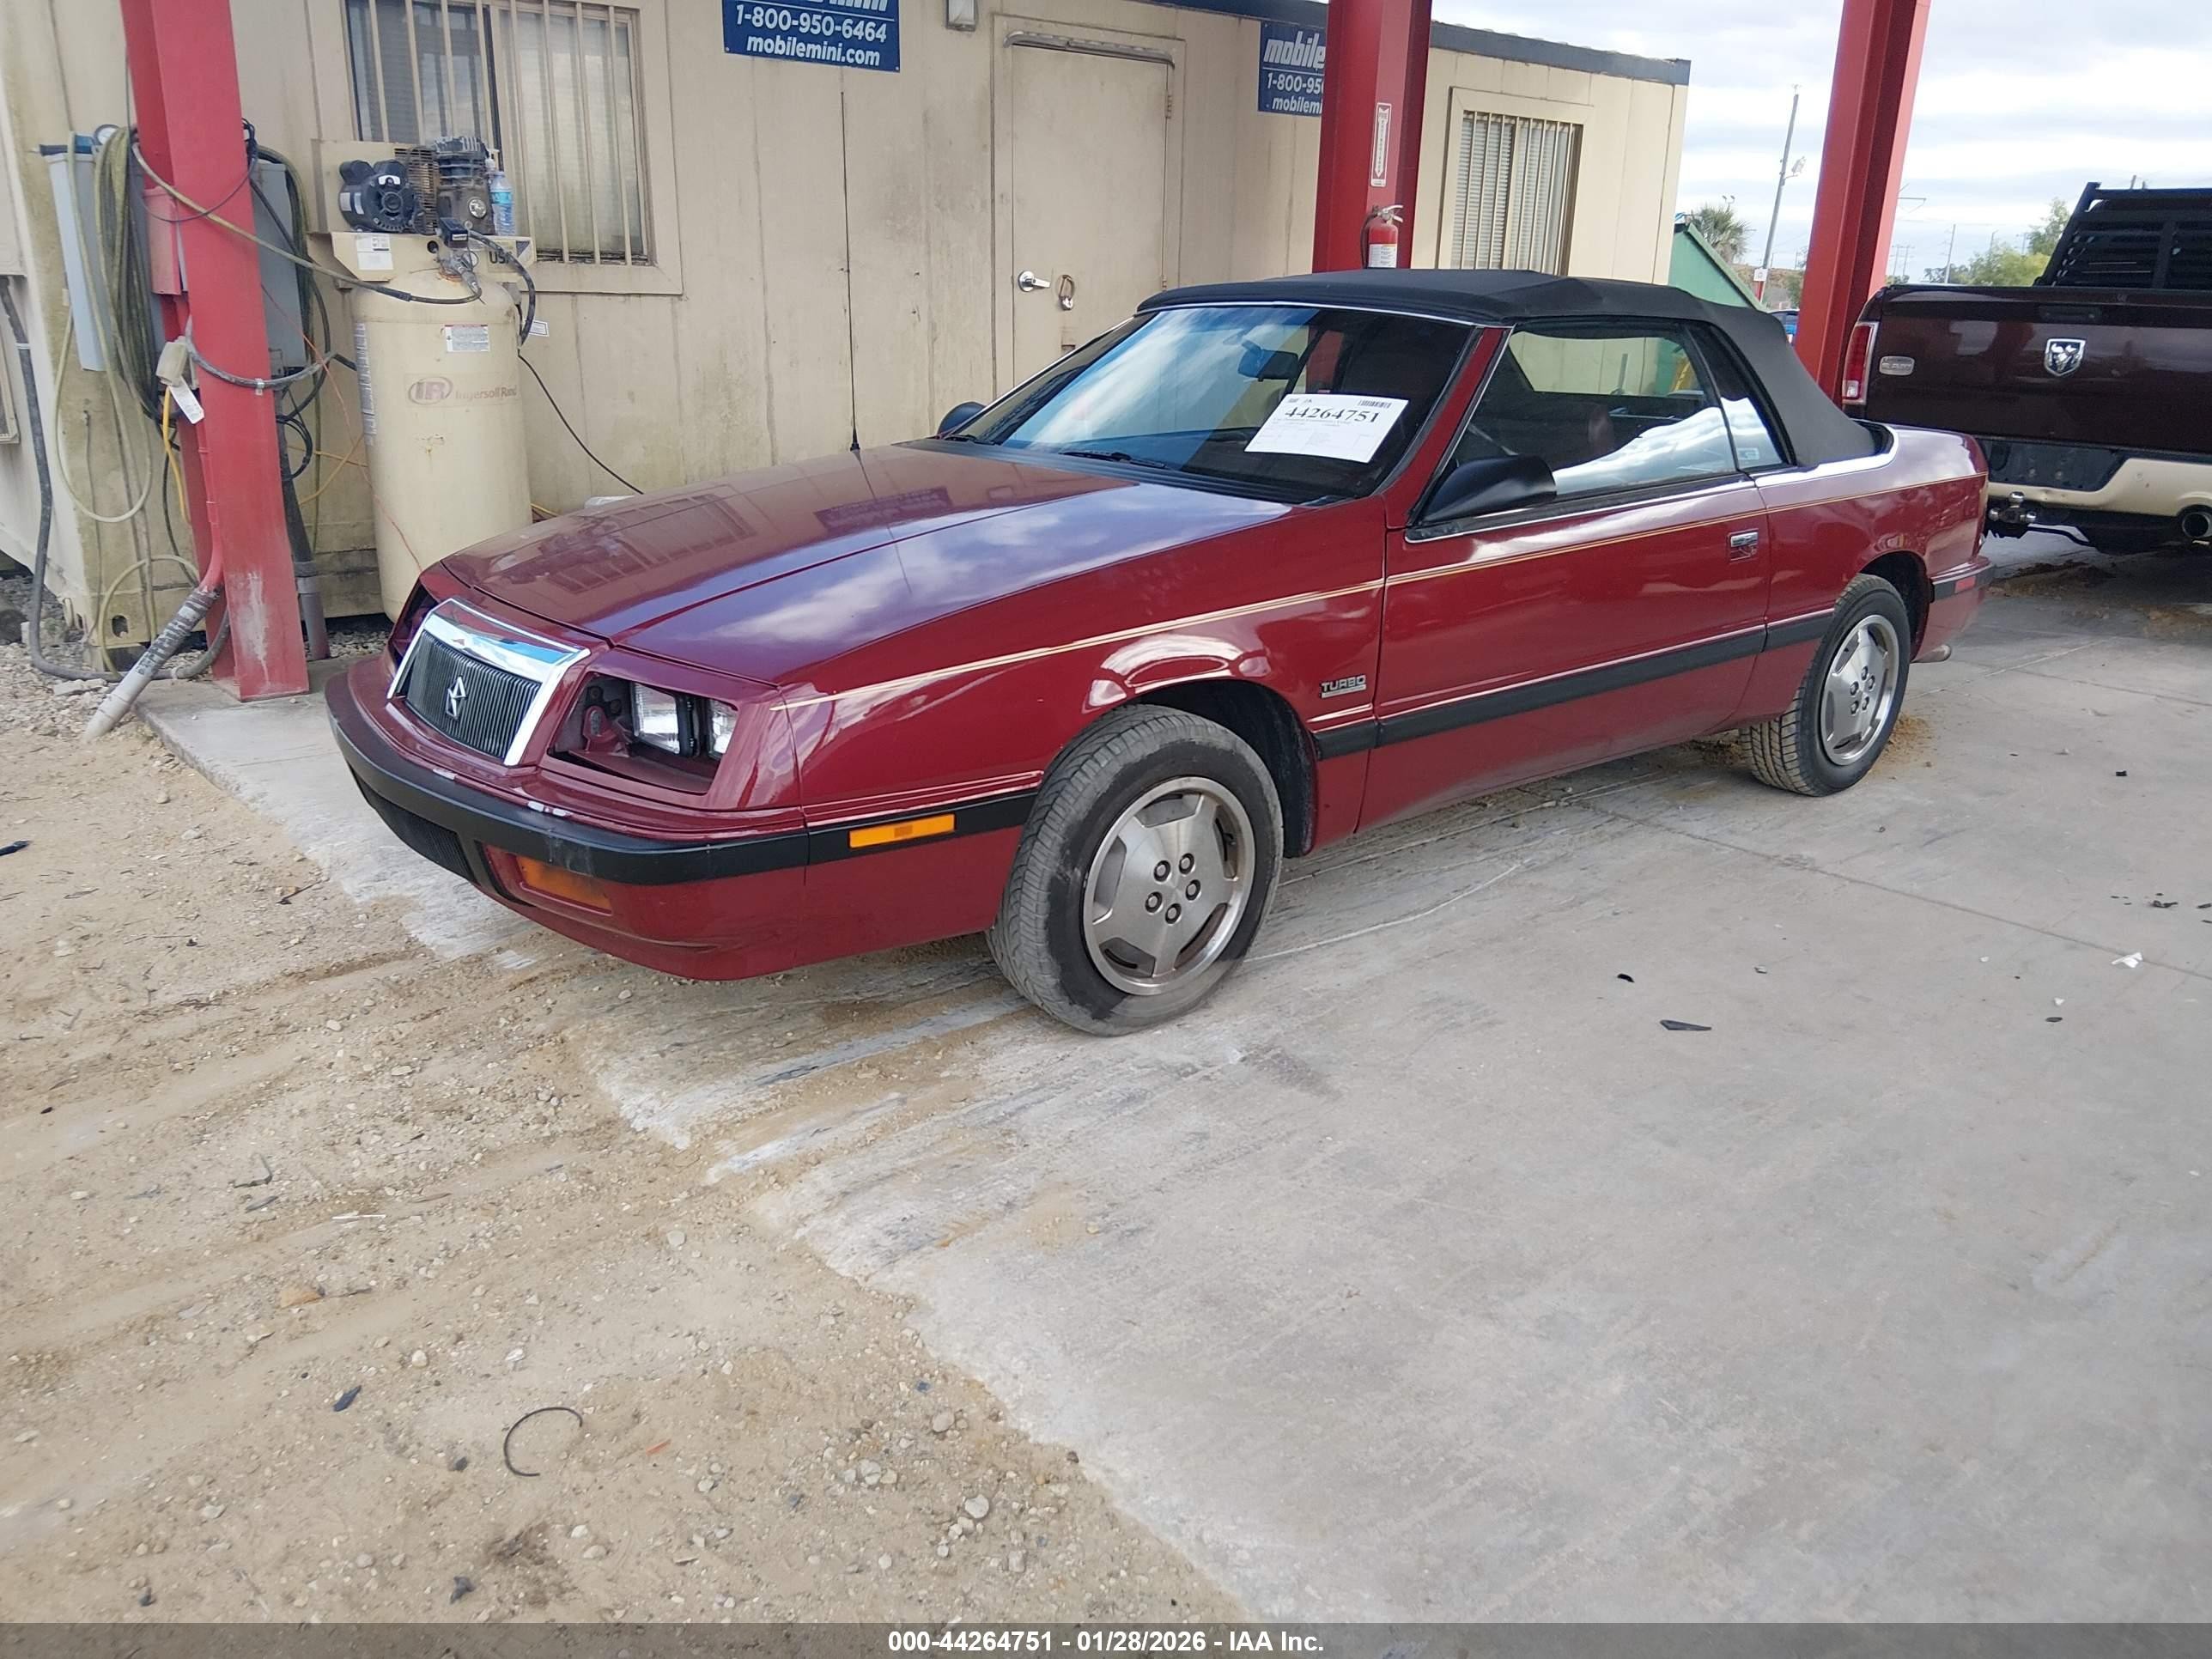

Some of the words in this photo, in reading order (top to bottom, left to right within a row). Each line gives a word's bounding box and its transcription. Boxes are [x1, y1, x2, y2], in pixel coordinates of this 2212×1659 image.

[736, 4, 887, 43] 1-800-950-6464
[746, 35, 880, 66] mobilemini.com
[1263, 31, 1326, 69] mobile
[1267, 72, 1323, 94] 1-800-95
[489, 251, 509, 264] US
[1285, 406, 1380, 422] 44264751
[1321, 674, 1366, 692] TURBO
